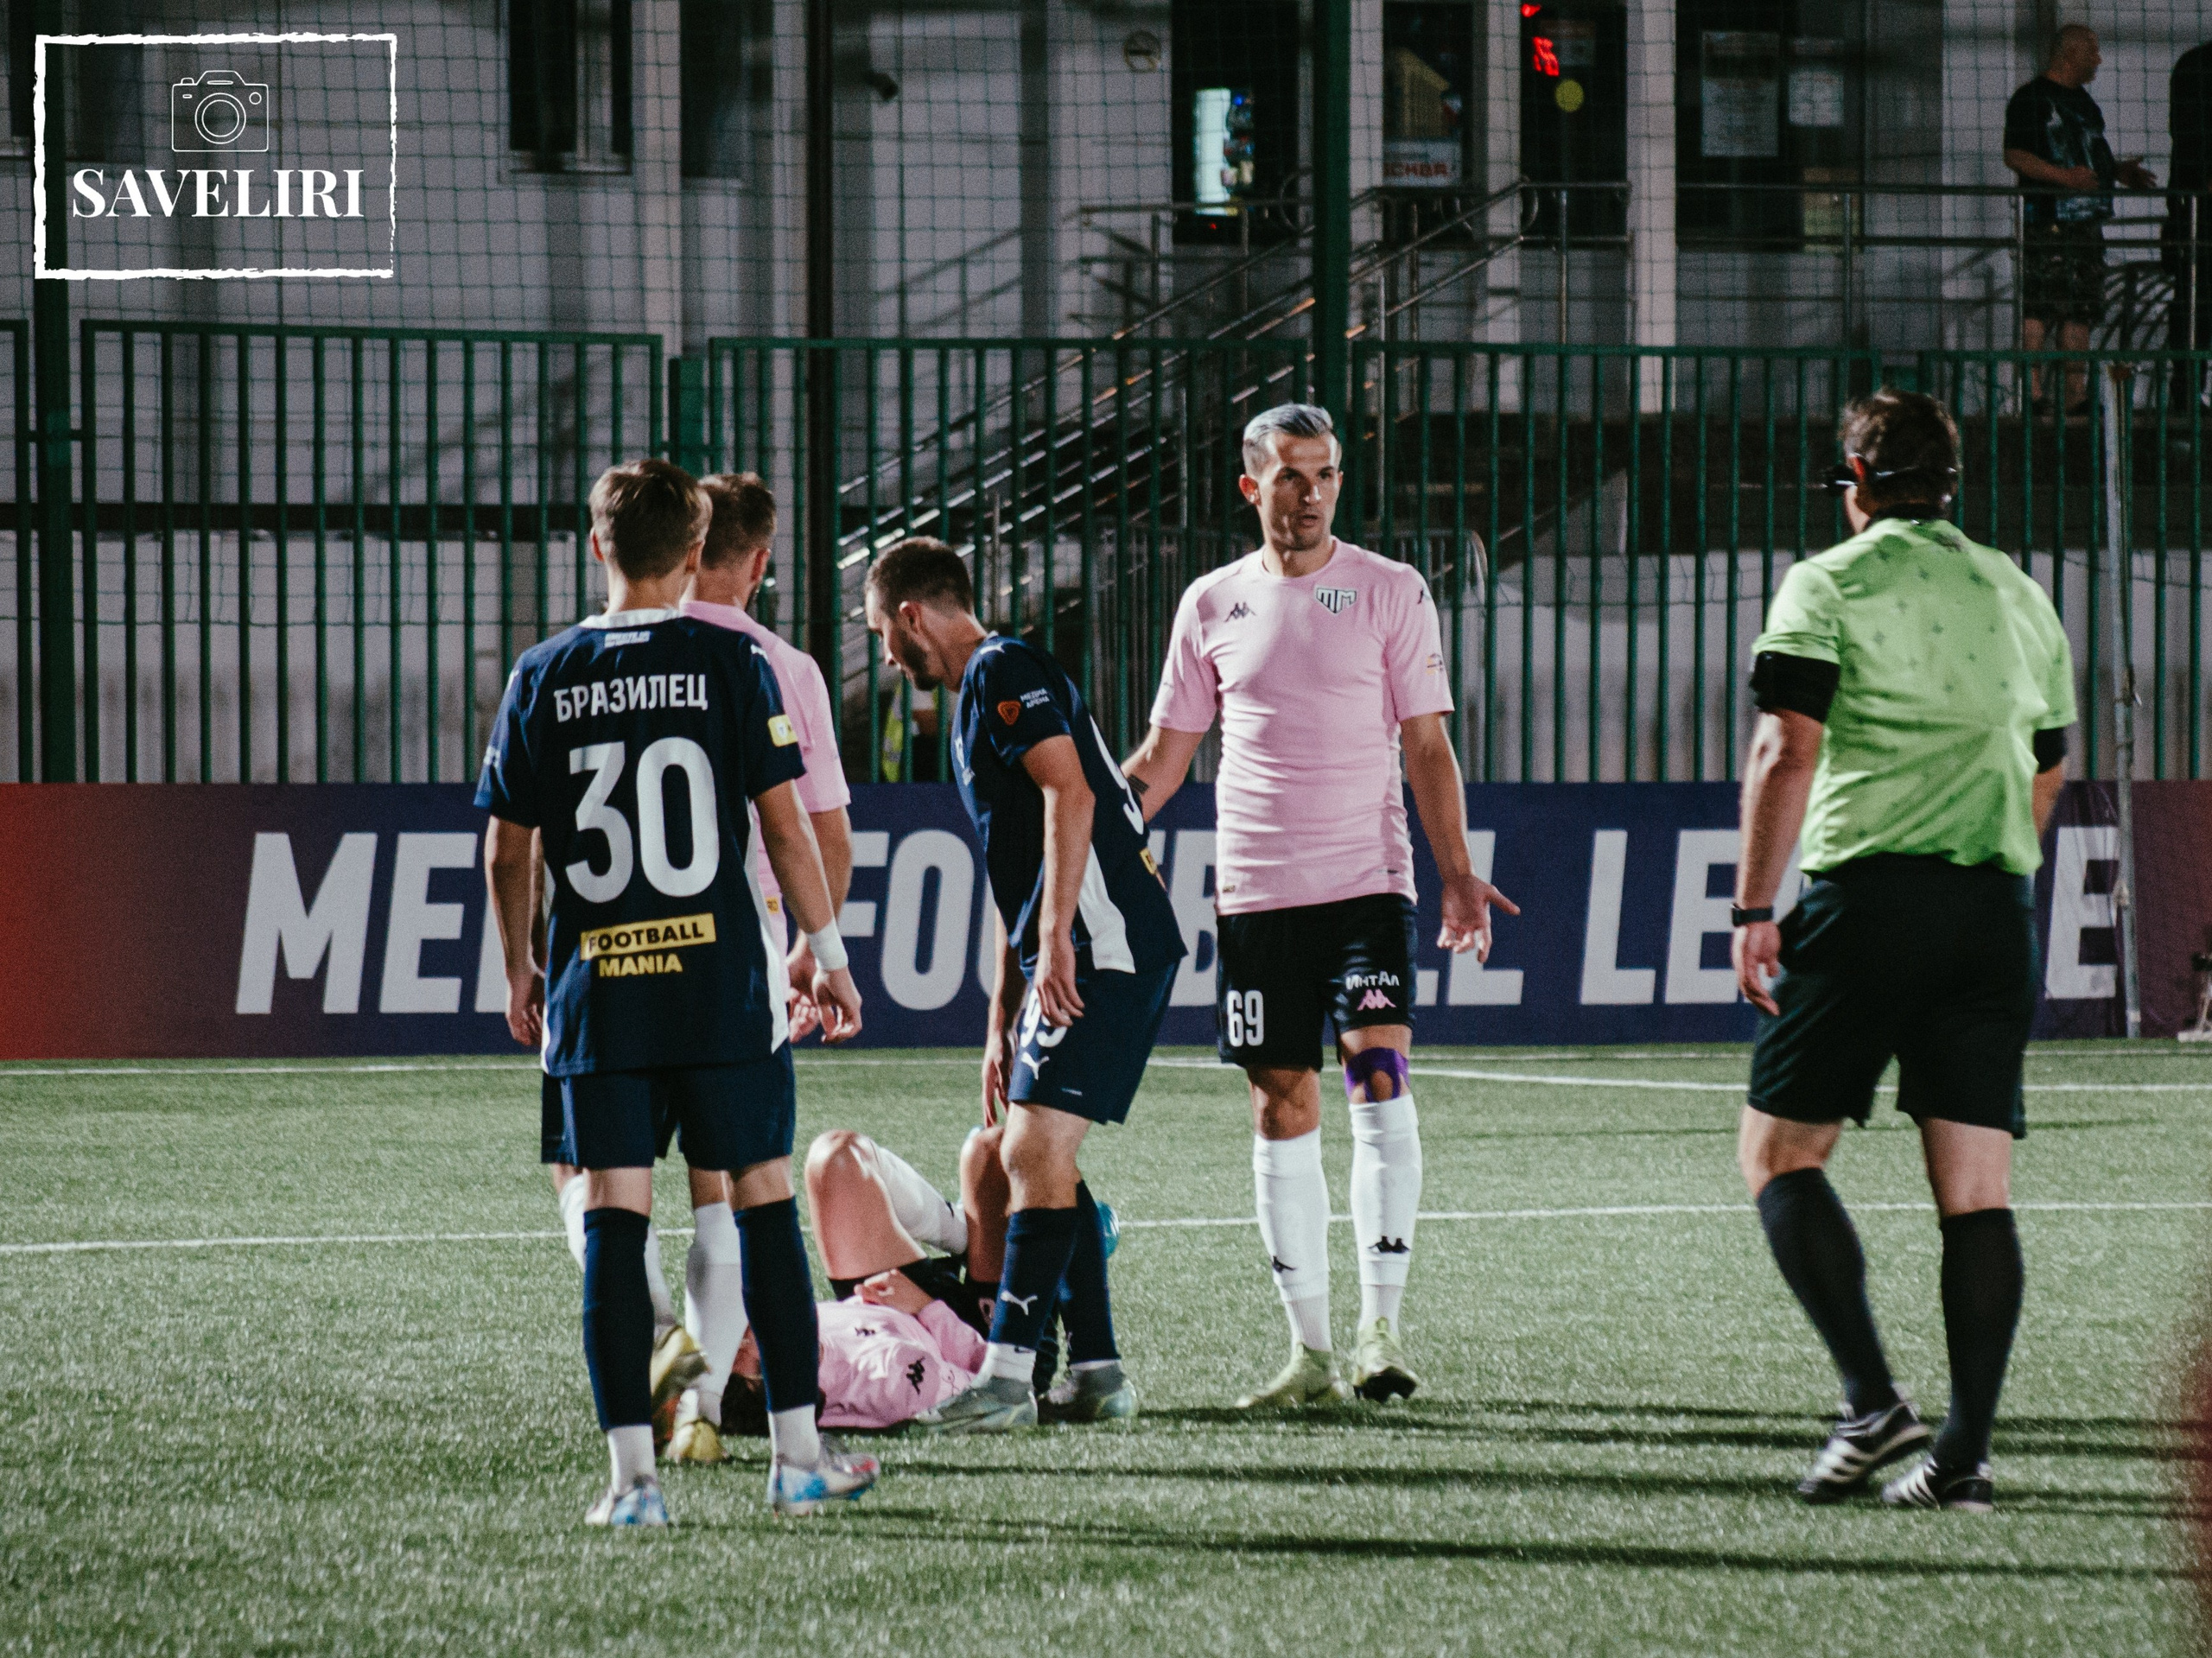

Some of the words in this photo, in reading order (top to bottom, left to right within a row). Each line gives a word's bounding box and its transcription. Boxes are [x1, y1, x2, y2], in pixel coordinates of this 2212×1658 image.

[554, 674, 709, 722] БРАЗИЛЕЦ
[565, 736, 720, 904] 30
[588, 922, 704, 952] FOOTBALL
[599, 953, 683, 977] MANIA
[1226, 990, 1264, 1047] 69
